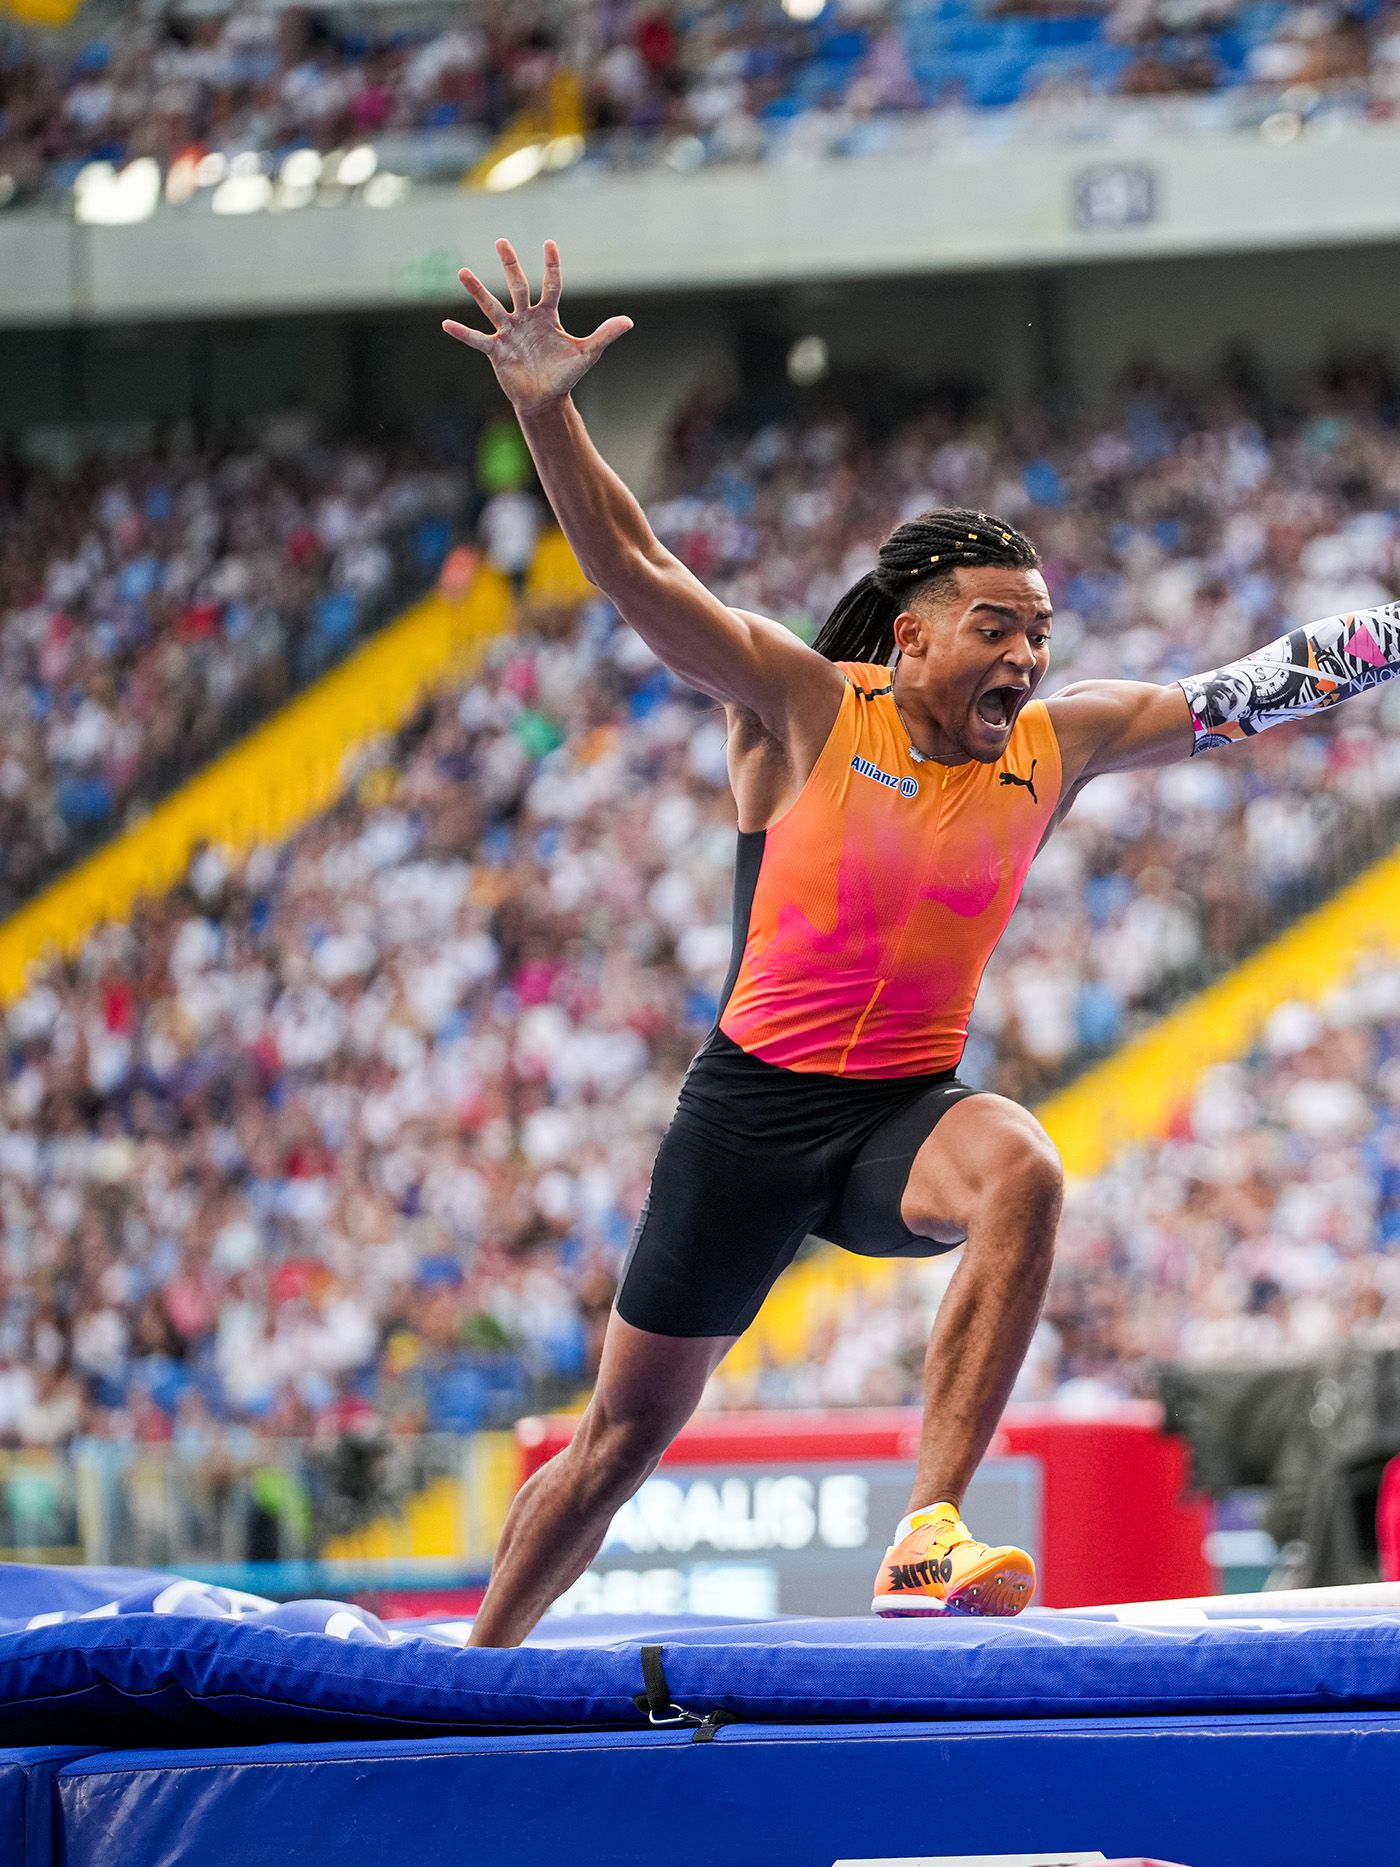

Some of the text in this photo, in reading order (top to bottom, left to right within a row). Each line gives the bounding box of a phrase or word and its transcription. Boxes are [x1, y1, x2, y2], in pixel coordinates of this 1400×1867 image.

[850, 755, 900, 789] Allianz
[818, 1474, 870, 1548] E
[888, 1558, 952, 1591] NITRO
